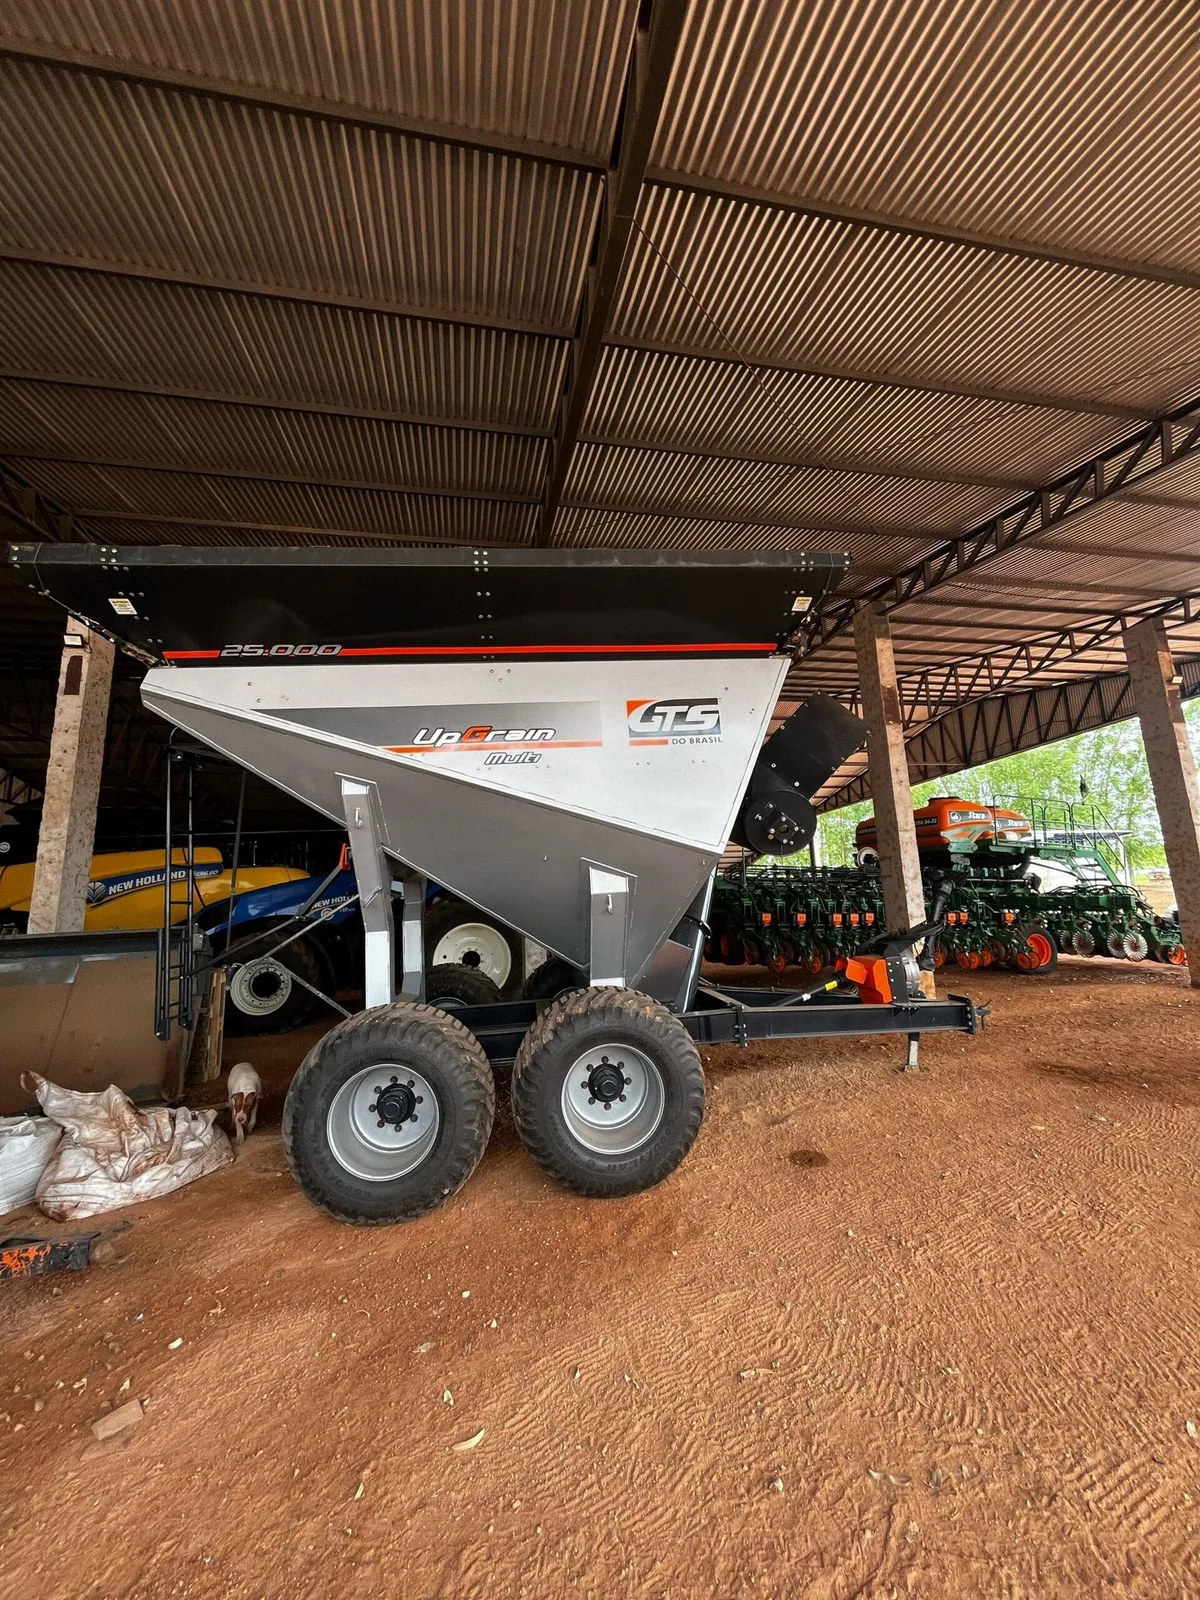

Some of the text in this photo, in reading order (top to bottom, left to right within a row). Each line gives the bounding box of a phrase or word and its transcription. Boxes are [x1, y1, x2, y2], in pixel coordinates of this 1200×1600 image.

[220, 644, 342, 657] 25.000
[627, 699, 720, 732] GTS
[412, 725, 556, 748] UpGrain
[689, 736, 723, 745] BRASIL
[484, 751, 542, 765] Multi
[968, 811, 986, 820] Stara
[1007, 819, 1024, 827] Stara
[108, 880, 134, 895] NEW
